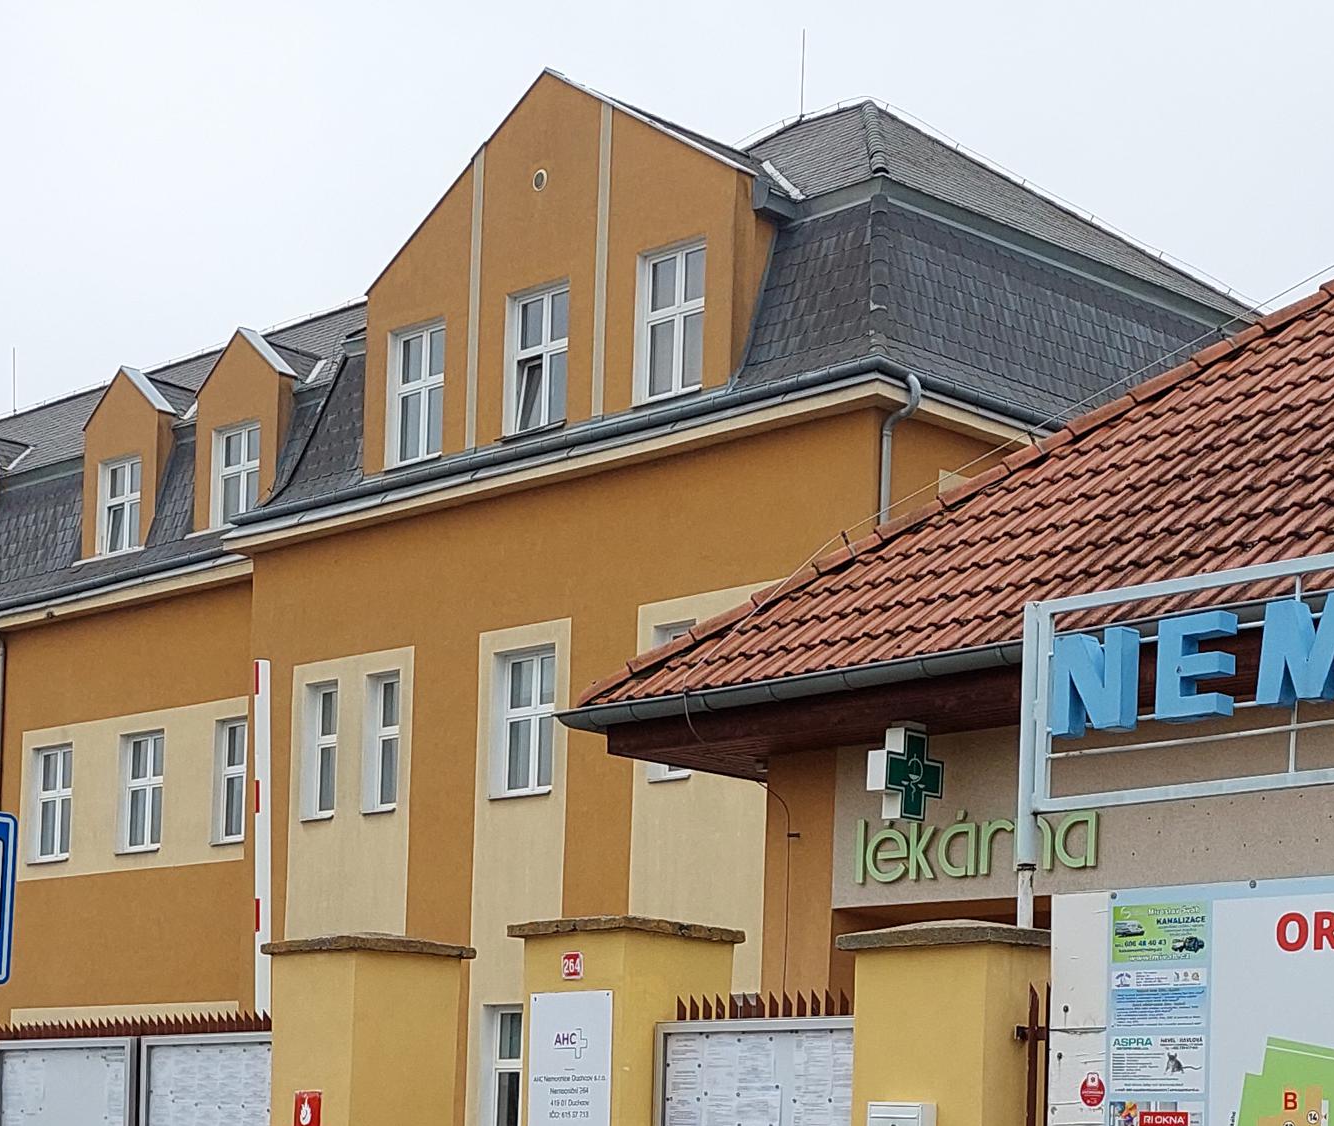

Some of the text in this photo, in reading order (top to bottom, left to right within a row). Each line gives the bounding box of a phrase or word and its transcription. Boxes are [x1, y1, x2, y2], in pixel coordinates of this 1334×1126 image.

[855, 810, 1098, 884] lékárna
[1156, 916, 1206, 925] KANALIZACE
[563, 959, 580, 973] 264
[555, 1033, 577, 1045] AHC
[1113, 1038, 1152, 1047] ASPRA
[1284, 1092, 1297, 1110] B
[1155, 1116, 1184, 1124] OKNA
